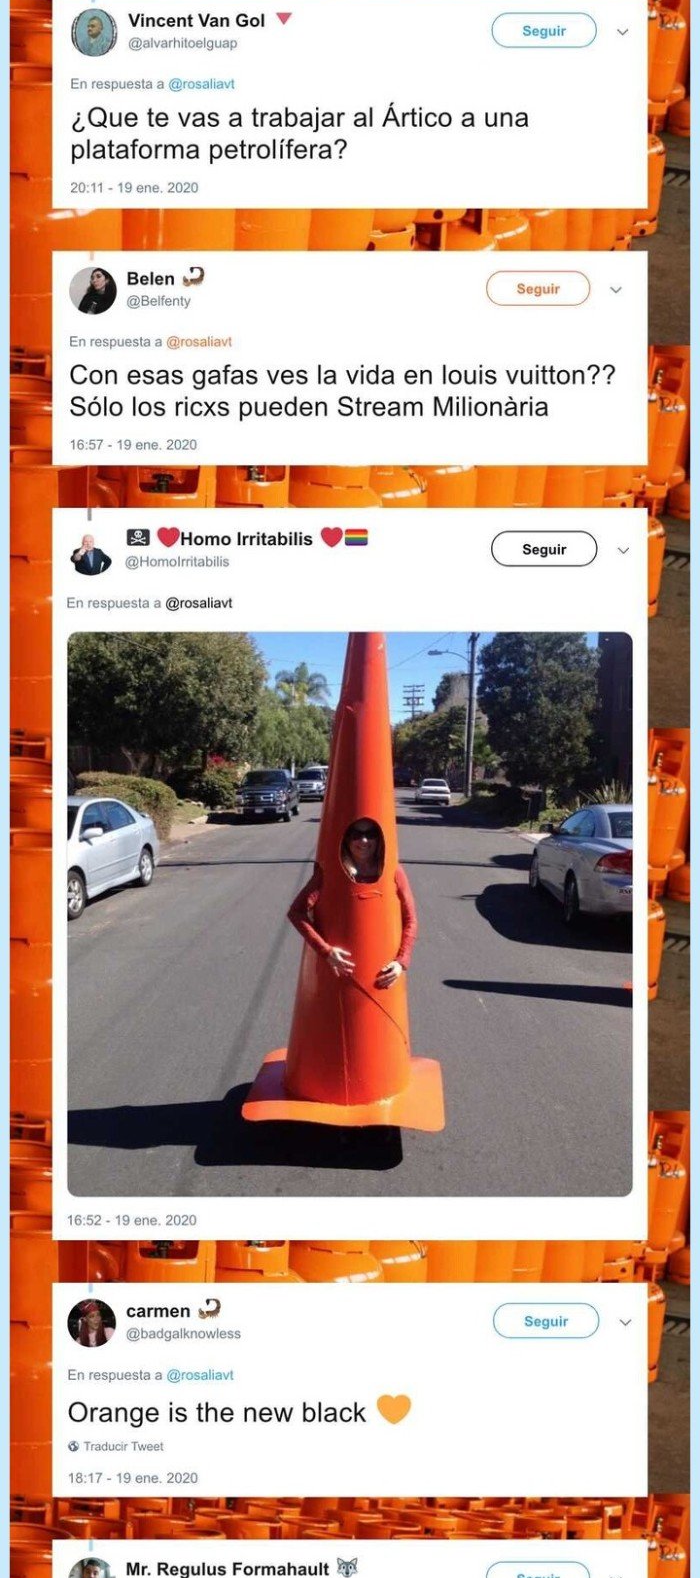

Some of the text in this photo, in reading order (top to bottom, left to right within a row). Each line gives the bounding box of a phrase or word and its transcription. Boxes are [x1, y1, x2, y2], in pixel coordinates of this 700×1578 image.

[128, 13, 265, 27] Vincent Van Gol
[129, 37, 237, 51] @alvarhitoelguap
[72, 102, 528, 133] ¿Que te vas a trabajar al Ártico a una
[72, 138, 347, 164] plataforma petrolífera?
[127, 271, 174, 285] Belen
[517, 283, 560, 297] Seguir
[127, 295, 191, 309] @Belfenty
[70, 364, 615, 390] Con esas gafas ves la vida en louis vuitton??
[70, 396, 548, 422] Sólo los ricxs pueden Stream Milionària
[181, 532, 313, 546] Homo Irritabilis
[125, 556, 229, 570] @HomoIrritabilis
[126, 1307, 190, 1318] carmen
[524, 1316, 568, 1330] Seguir
[127, 1328, 241, 1341] @badgalknowless
[68, 1401, 366, 1428] Orange is the new black
[84, 1442, 163, 1451] Traducir Tweet
[126, 1562, 329, 1578] Mr. Regulus Formahault
